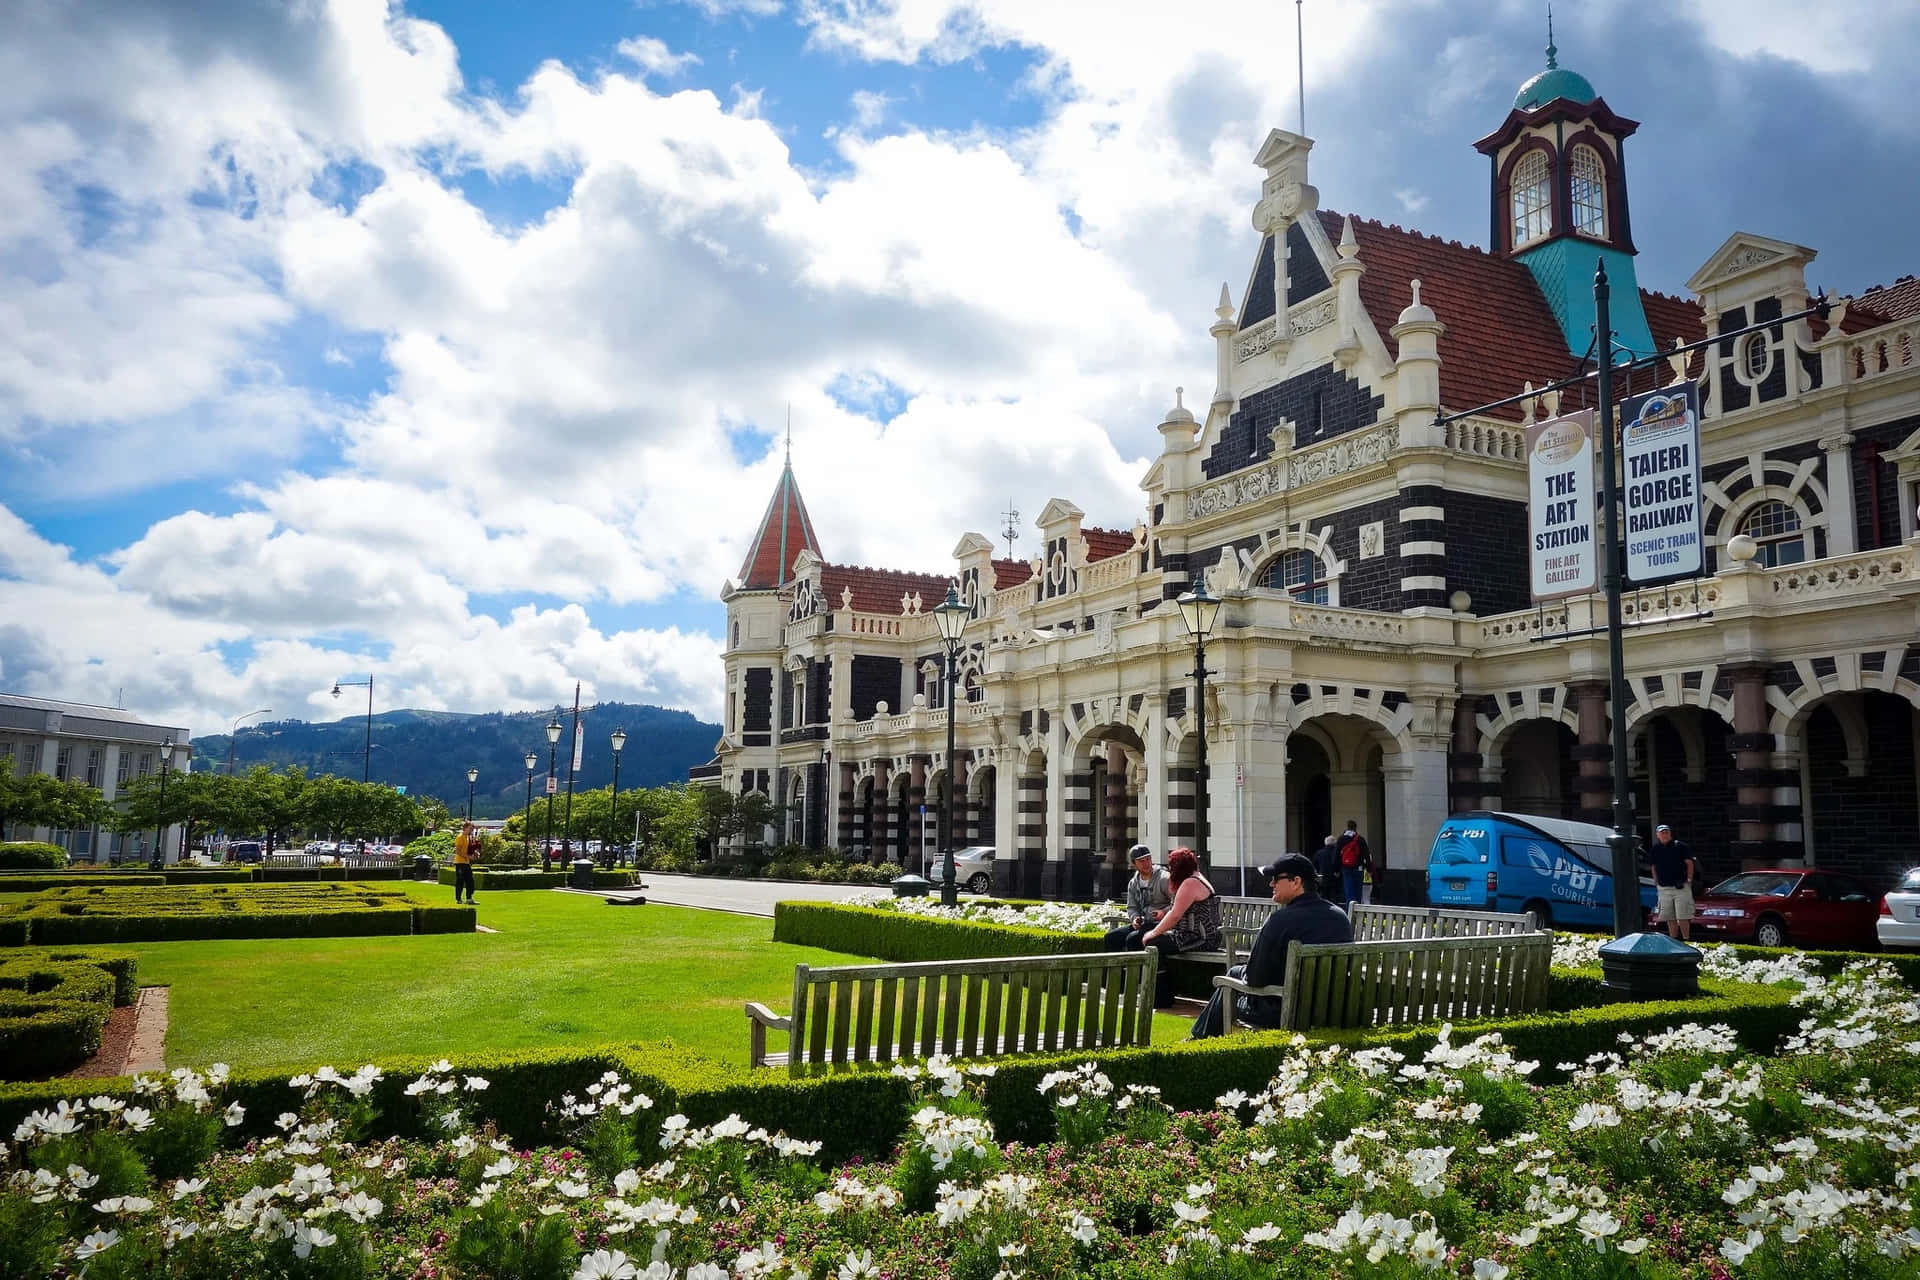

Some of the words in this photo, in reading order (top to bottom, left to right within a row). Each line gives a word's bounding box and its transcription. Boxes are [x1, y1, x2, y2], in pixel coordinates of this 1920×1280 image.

[1629, 444, 1688, 479] TAIERI
[1545, 471, 1576, 497] THE
[1629, 474, 1693, 508] GORGE
[1546, 500, 1577, 526] ART
[1630, 503, 1694, 533] RAILWAY
[1536, 525, 1589, 550] STATION
[1630, 537, 1665, 555] SCENIC
[1667, 533, 1696, 550] TRAIN
[1545, 556, 1563, 570] FINE
[1564, 554, 1580, 566] ART
[1647, 551, 1679, 567] TOURS
[1546, 568, 1580, 584] GALLERY
[1462, 829, 1485, 838] PBT
[1553, 856, 1603, 894] PBT
[1551, 883, 1597, 910] COURIERS
